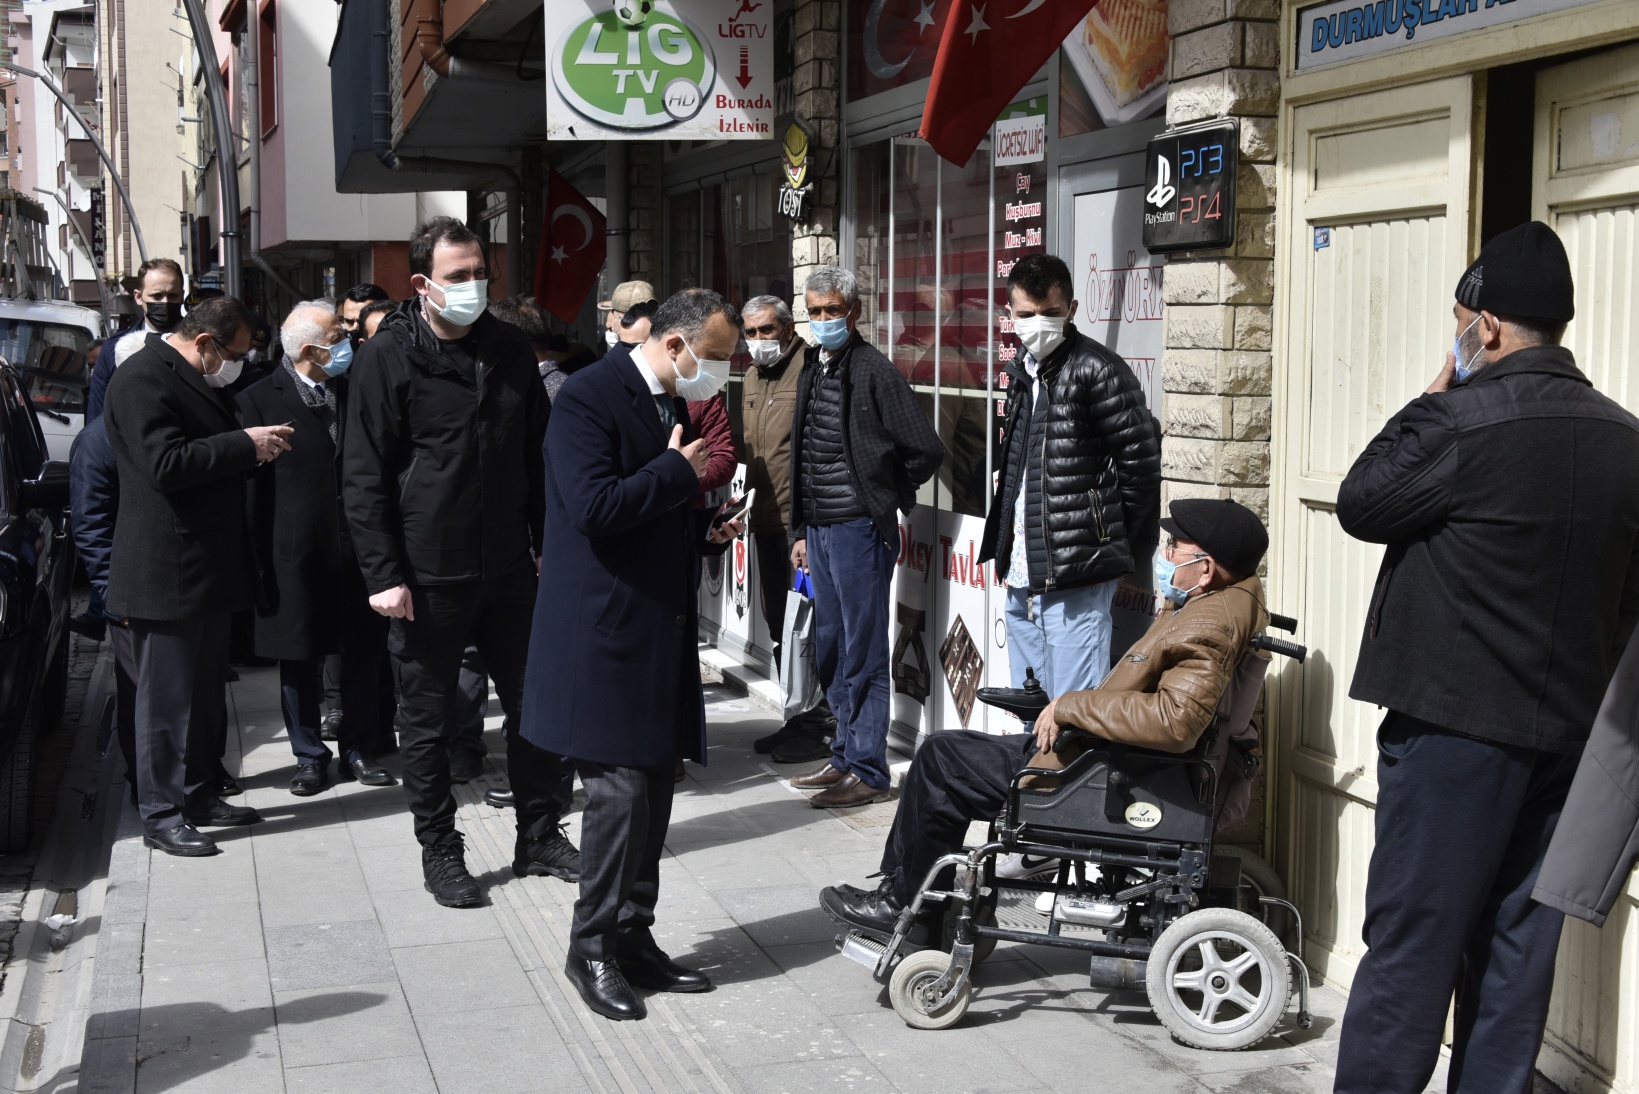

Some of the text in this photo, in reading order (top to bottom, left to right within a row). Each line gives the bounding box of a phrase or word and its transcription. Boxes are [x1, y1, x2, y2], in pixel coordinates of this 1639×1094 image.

[1311, 0, 1478, 53] DURMUŞLAR
[611, 69, 660, 94] TV
[668, 92, 696, 107] HD
[1181, 144, 1223, 178] PS3
[1016, 172, 1031, 194] Çay
[778, 186, 806, 217] TOST
[1005, 200, 1041, 223] Kuşburnu
[1179, 191, 1221, 224] PS4
[1145, 211, 1175, 227] PlayStation
[1004, 231, 1021, 249] Muz
[1026, 227, 1042, 246] Kivi
